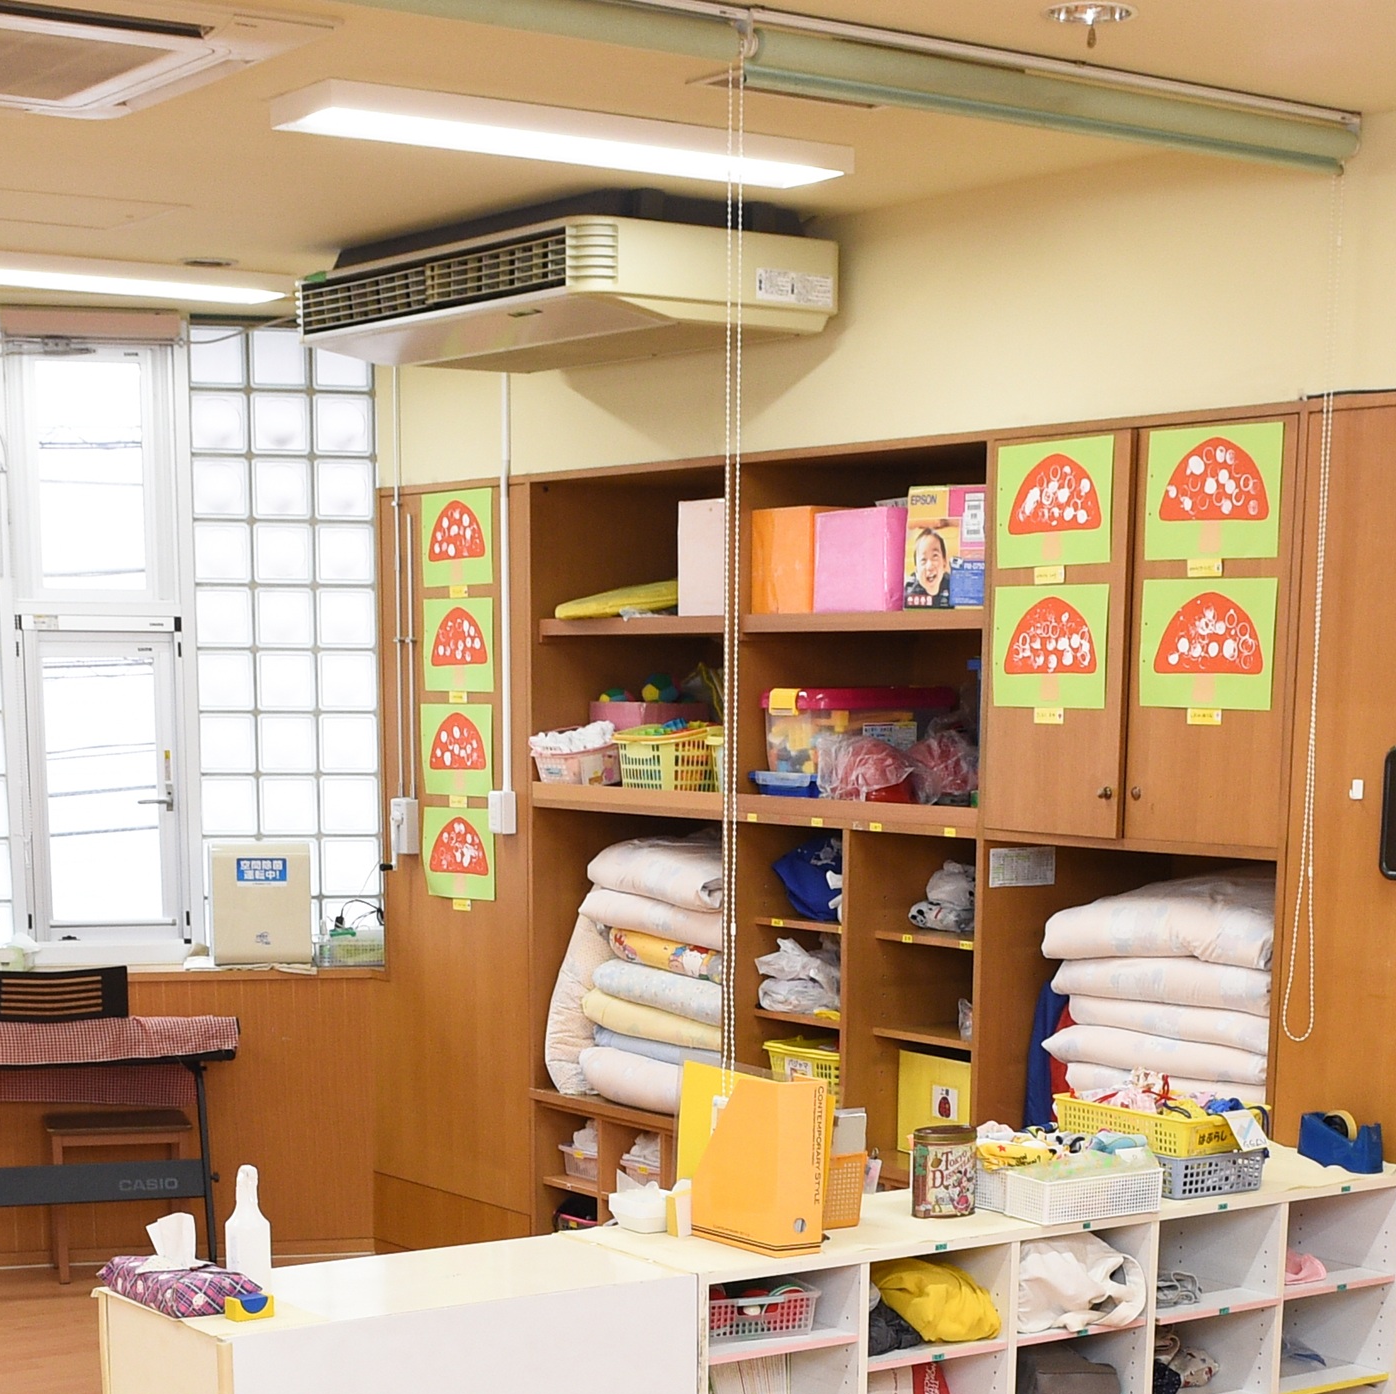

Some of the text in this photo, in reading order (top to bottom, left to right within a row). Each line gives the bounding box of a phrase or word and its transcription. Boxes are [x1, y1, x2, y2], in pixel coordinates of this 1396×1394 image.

[910, 494, 937, 505] EPSON
[815, 1086, 825, 1171] CONTEMPORARY
[1198, 1130, 1228, 1146] はぶらし
[940, 1150, 968, 1171] TOKYO
[118, 1177, 179, 1191] CASIO
[813, 1172, 822, 1205] STYLE
